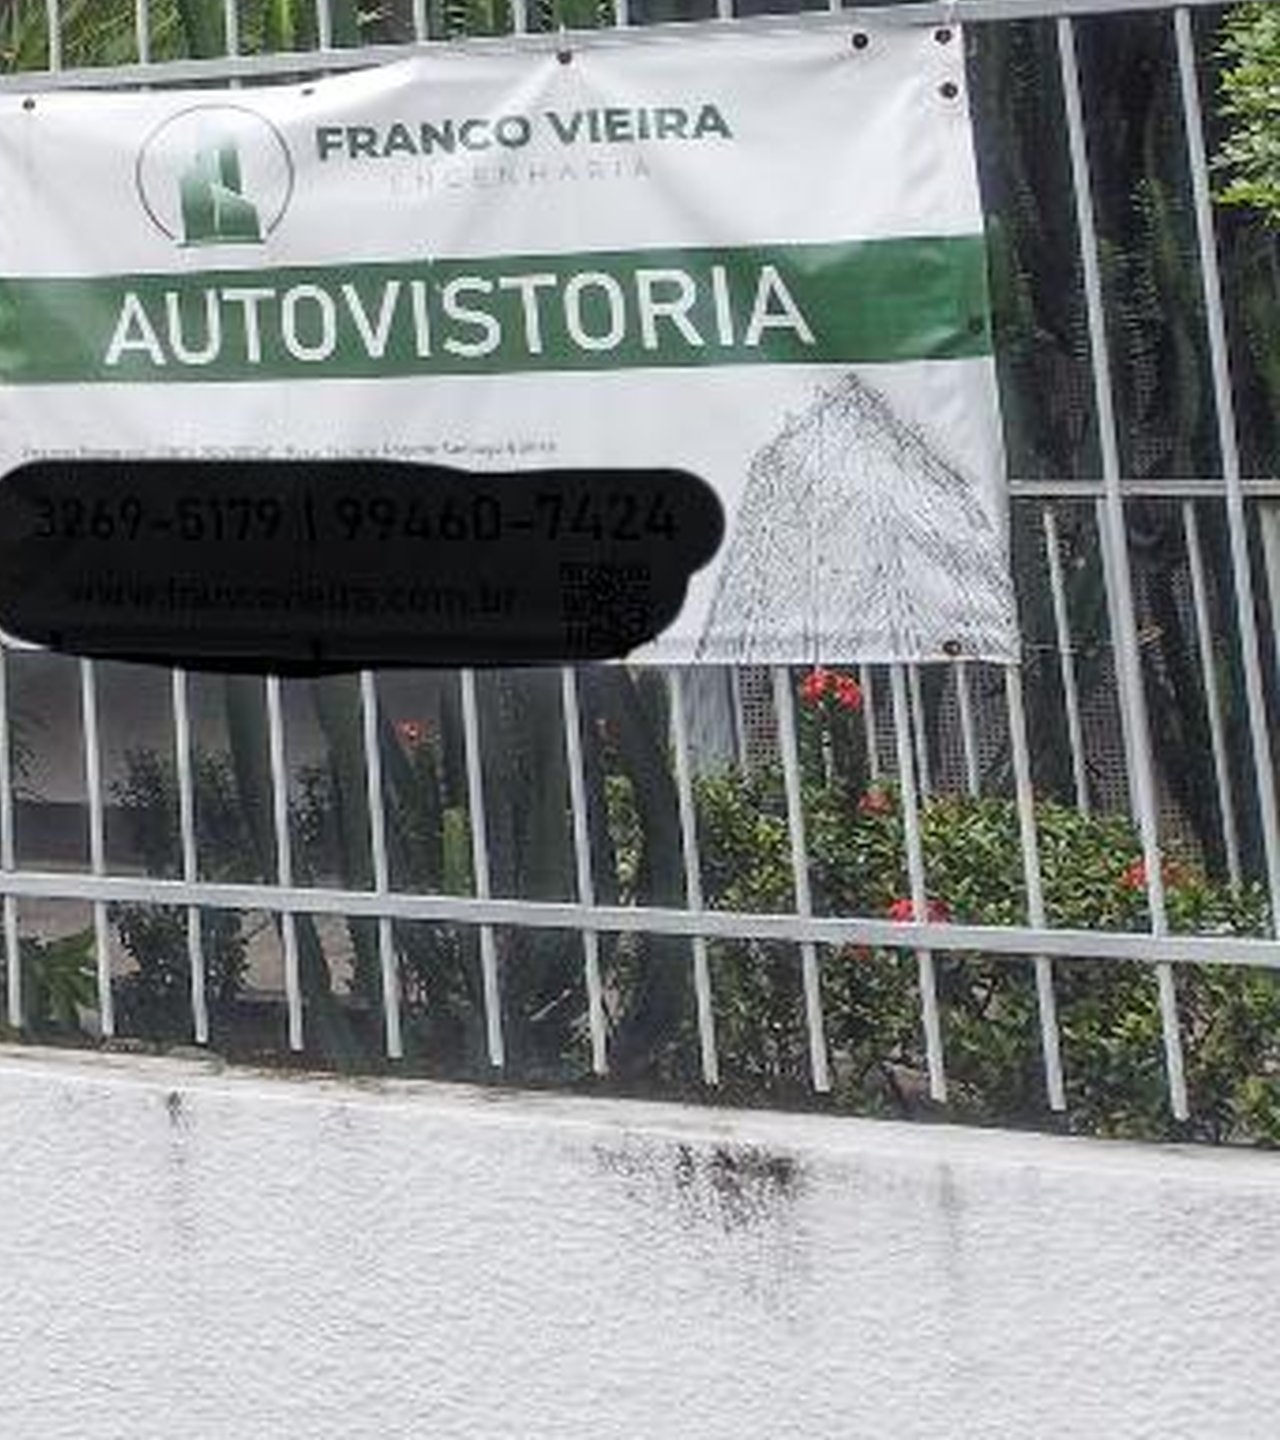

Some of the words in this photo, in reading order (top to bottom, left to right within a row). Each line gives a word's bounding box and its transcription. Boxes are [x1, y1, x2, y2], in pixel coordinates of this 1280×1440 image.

[316, 115, 533, 161] FRANCO
[546, 104, 734, 146] VIEIRA
[103, 262, 818, 368] AUTOVISTORIA
